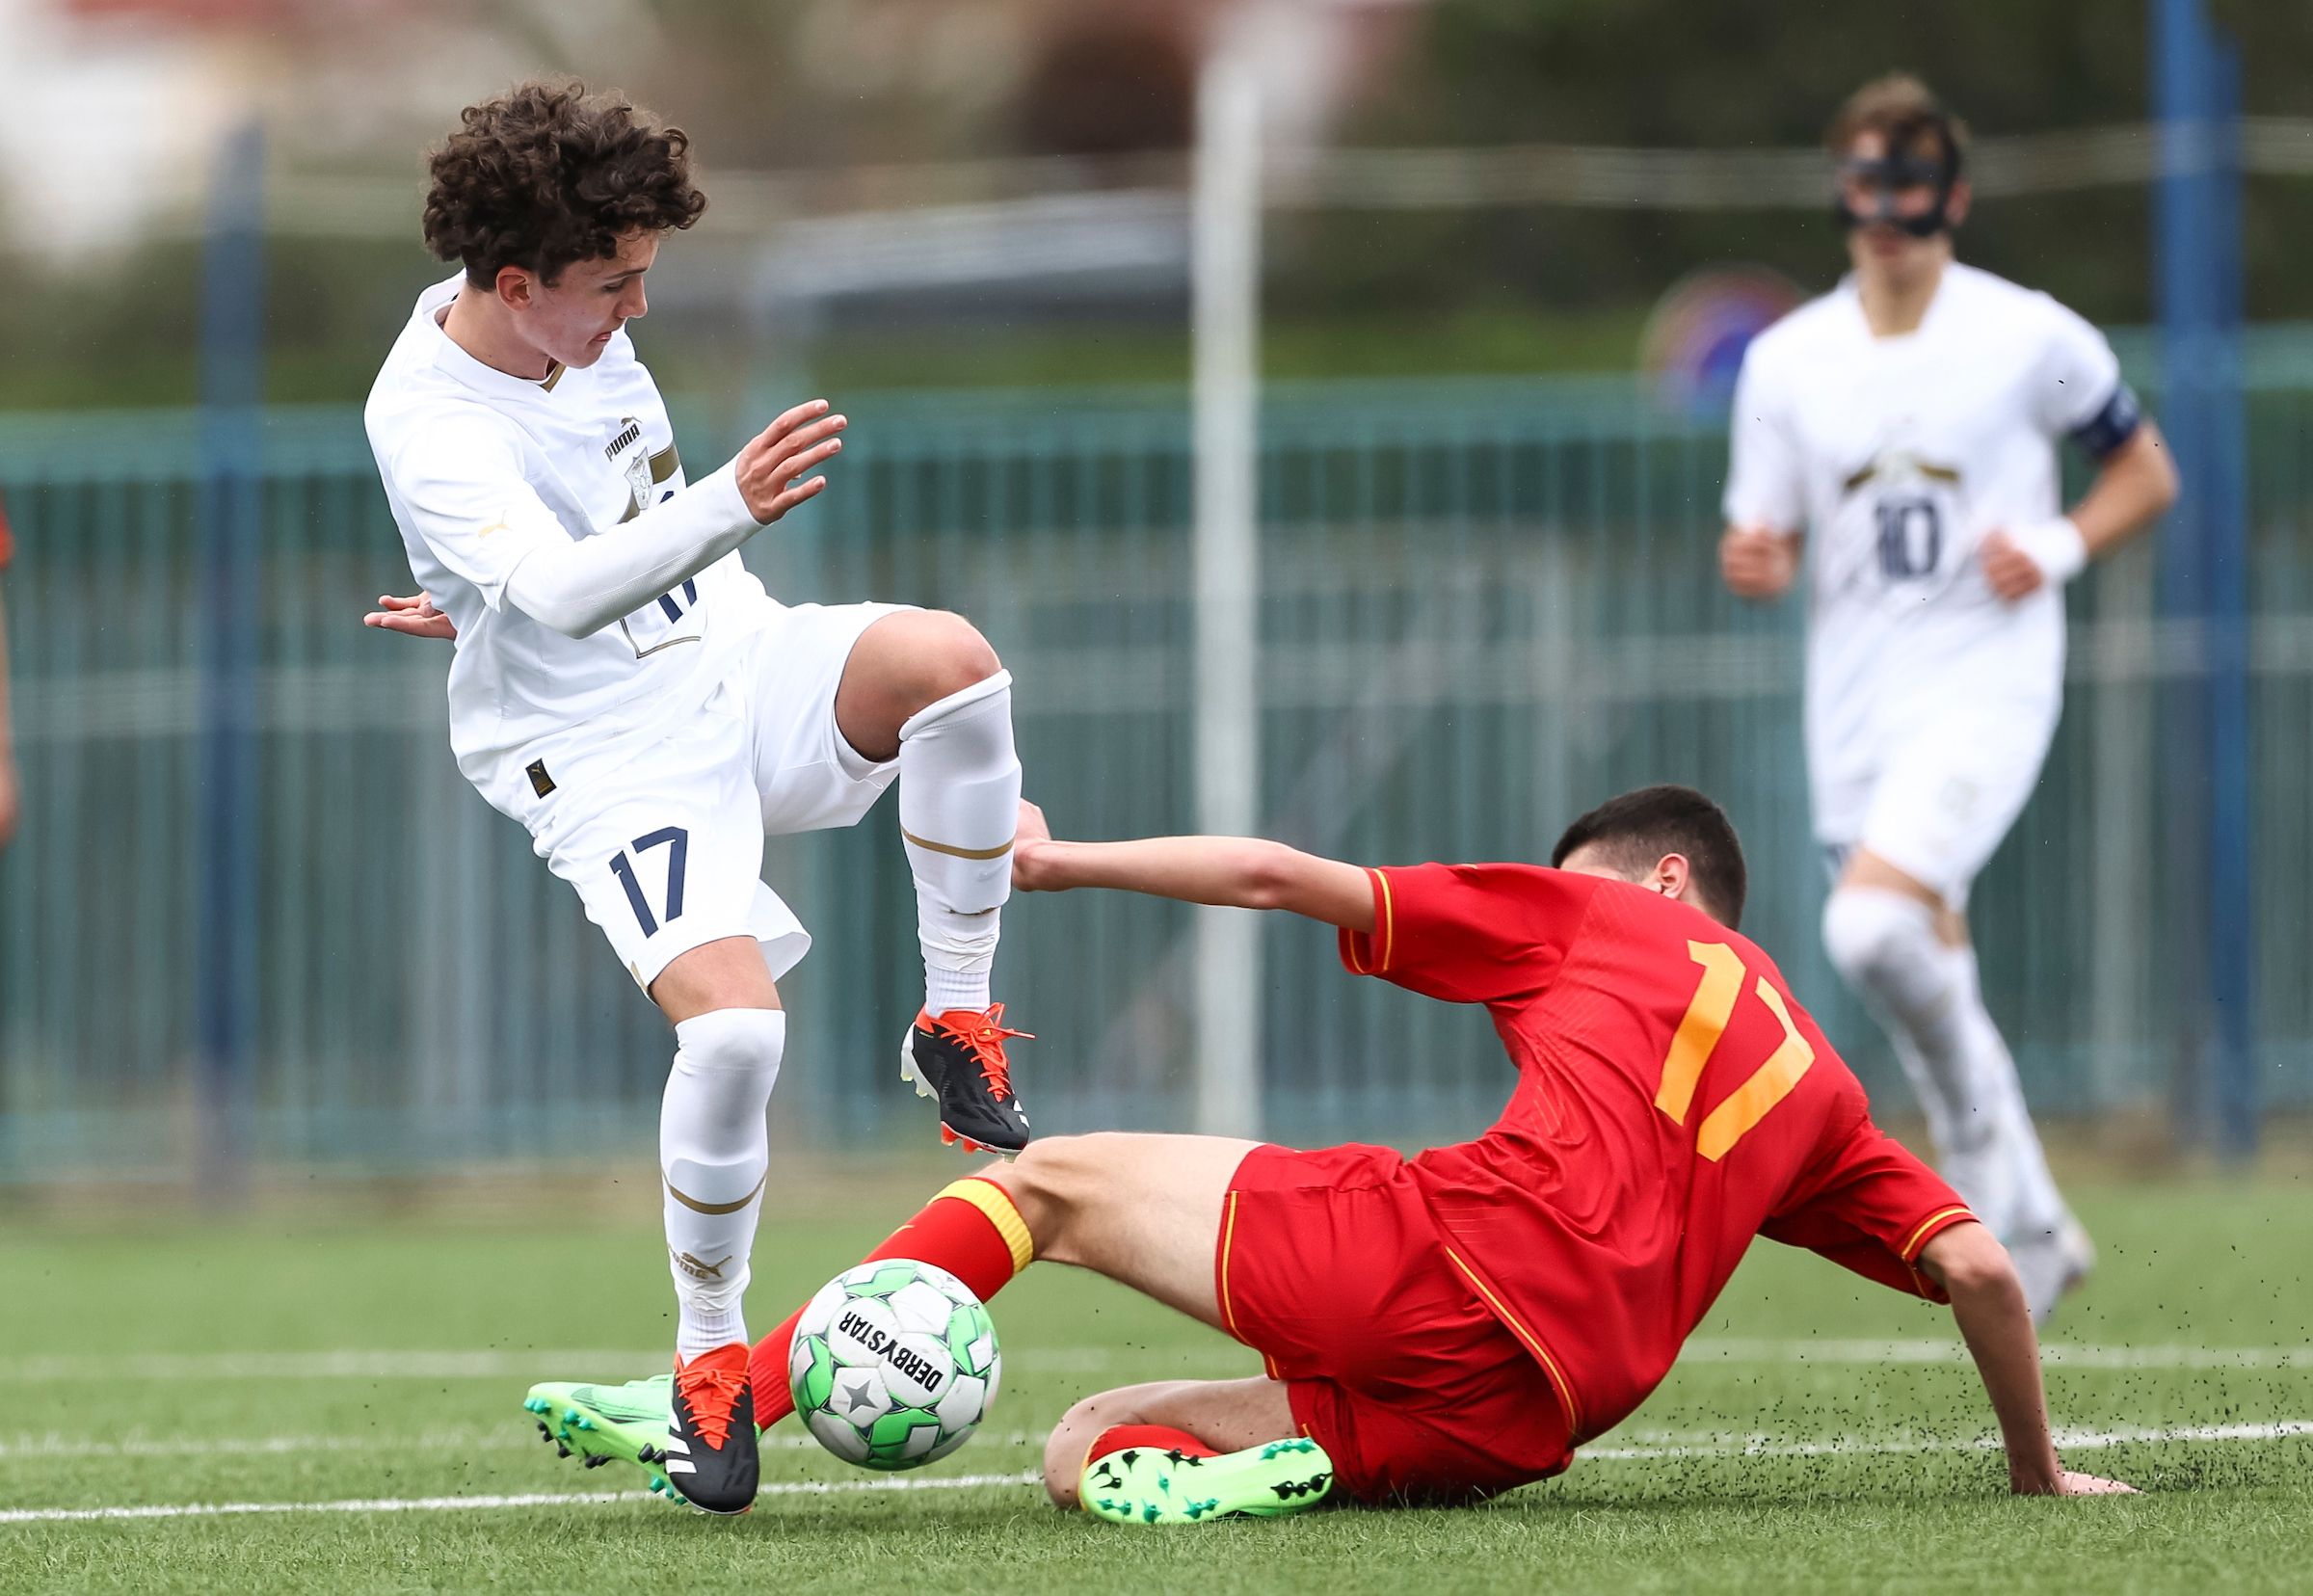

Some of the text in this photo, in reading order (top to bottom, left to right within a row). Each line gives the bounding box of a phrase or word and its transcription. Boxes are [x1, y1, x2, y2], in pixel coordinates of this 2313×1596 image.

[604, 423, 641, 463] PUMA
[1874, 494, 1940, 580] 10
[608, 826, 688, 939] 17
[1654, 939, 1816, 1163] 17
[837, 1311, 944, 1394] DERBYSTAR
